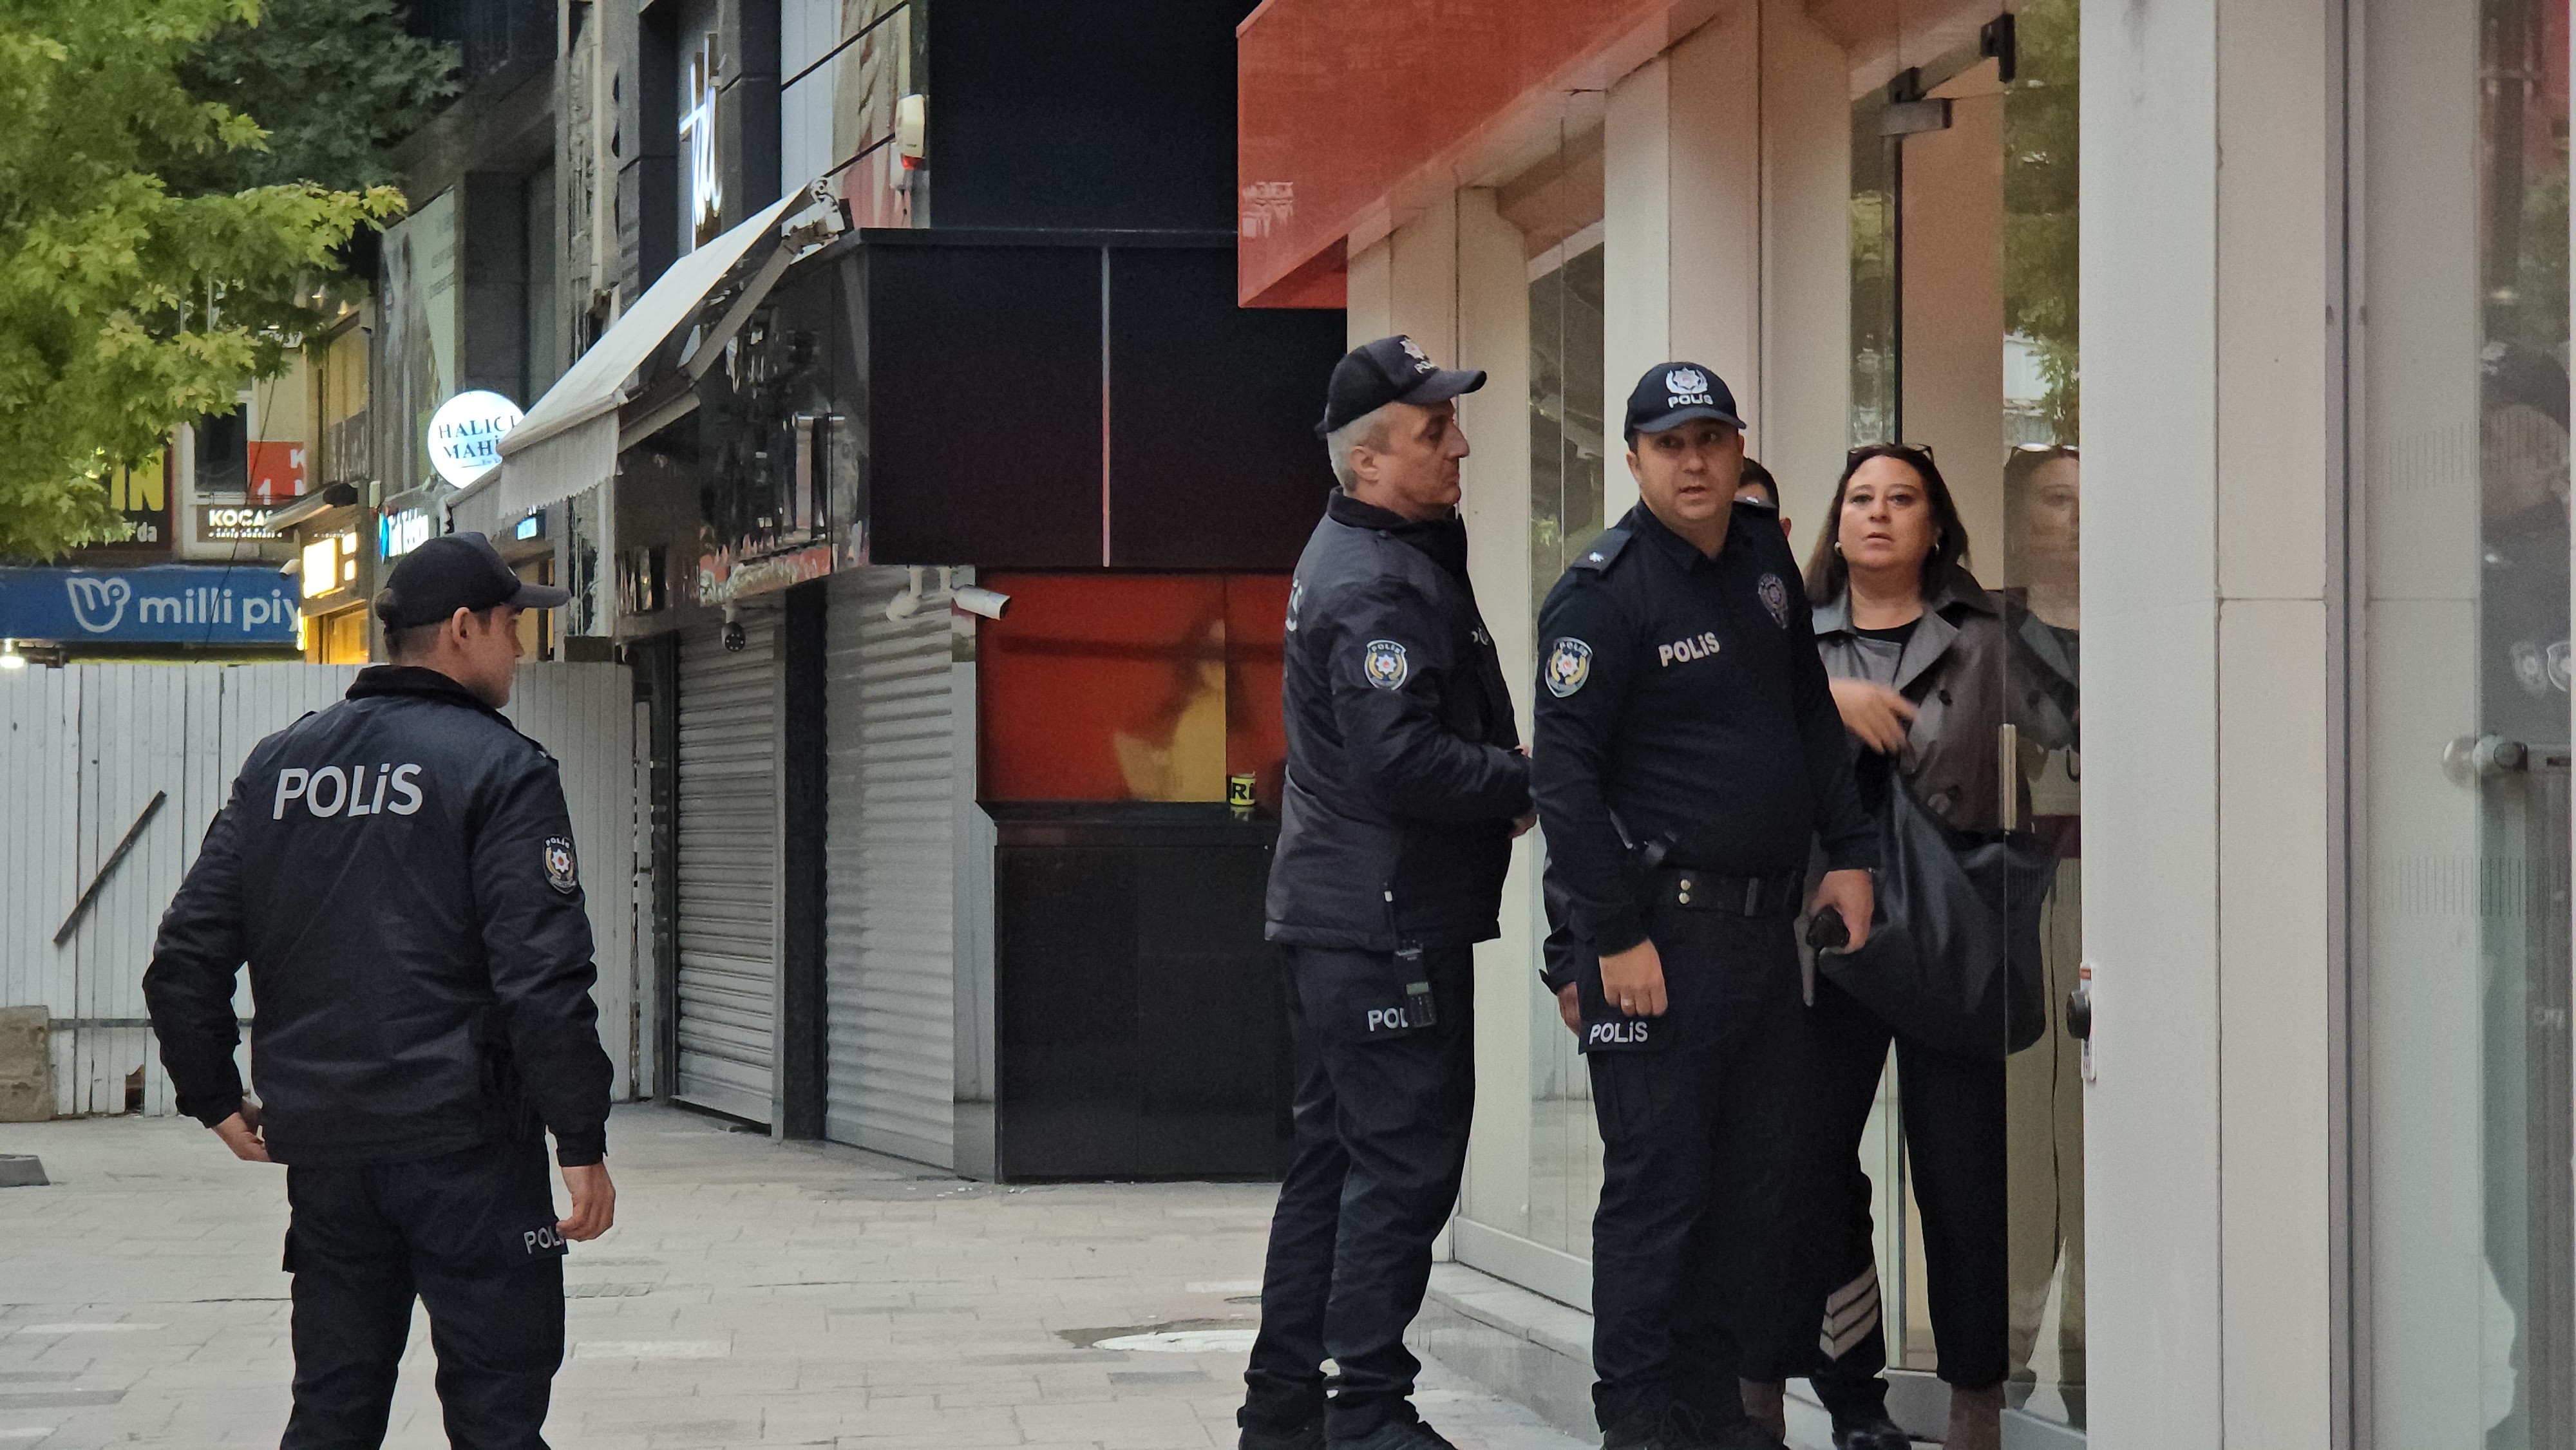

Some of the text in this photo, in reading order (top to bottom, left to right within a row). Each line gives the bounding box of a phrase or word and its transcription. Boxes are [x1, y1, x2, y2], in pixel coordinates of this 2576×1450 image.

[140, 587, 232, 624] milli
[1367, 1008, 1408, 1031] POL
[524, 1225, 561, 1254] POL
